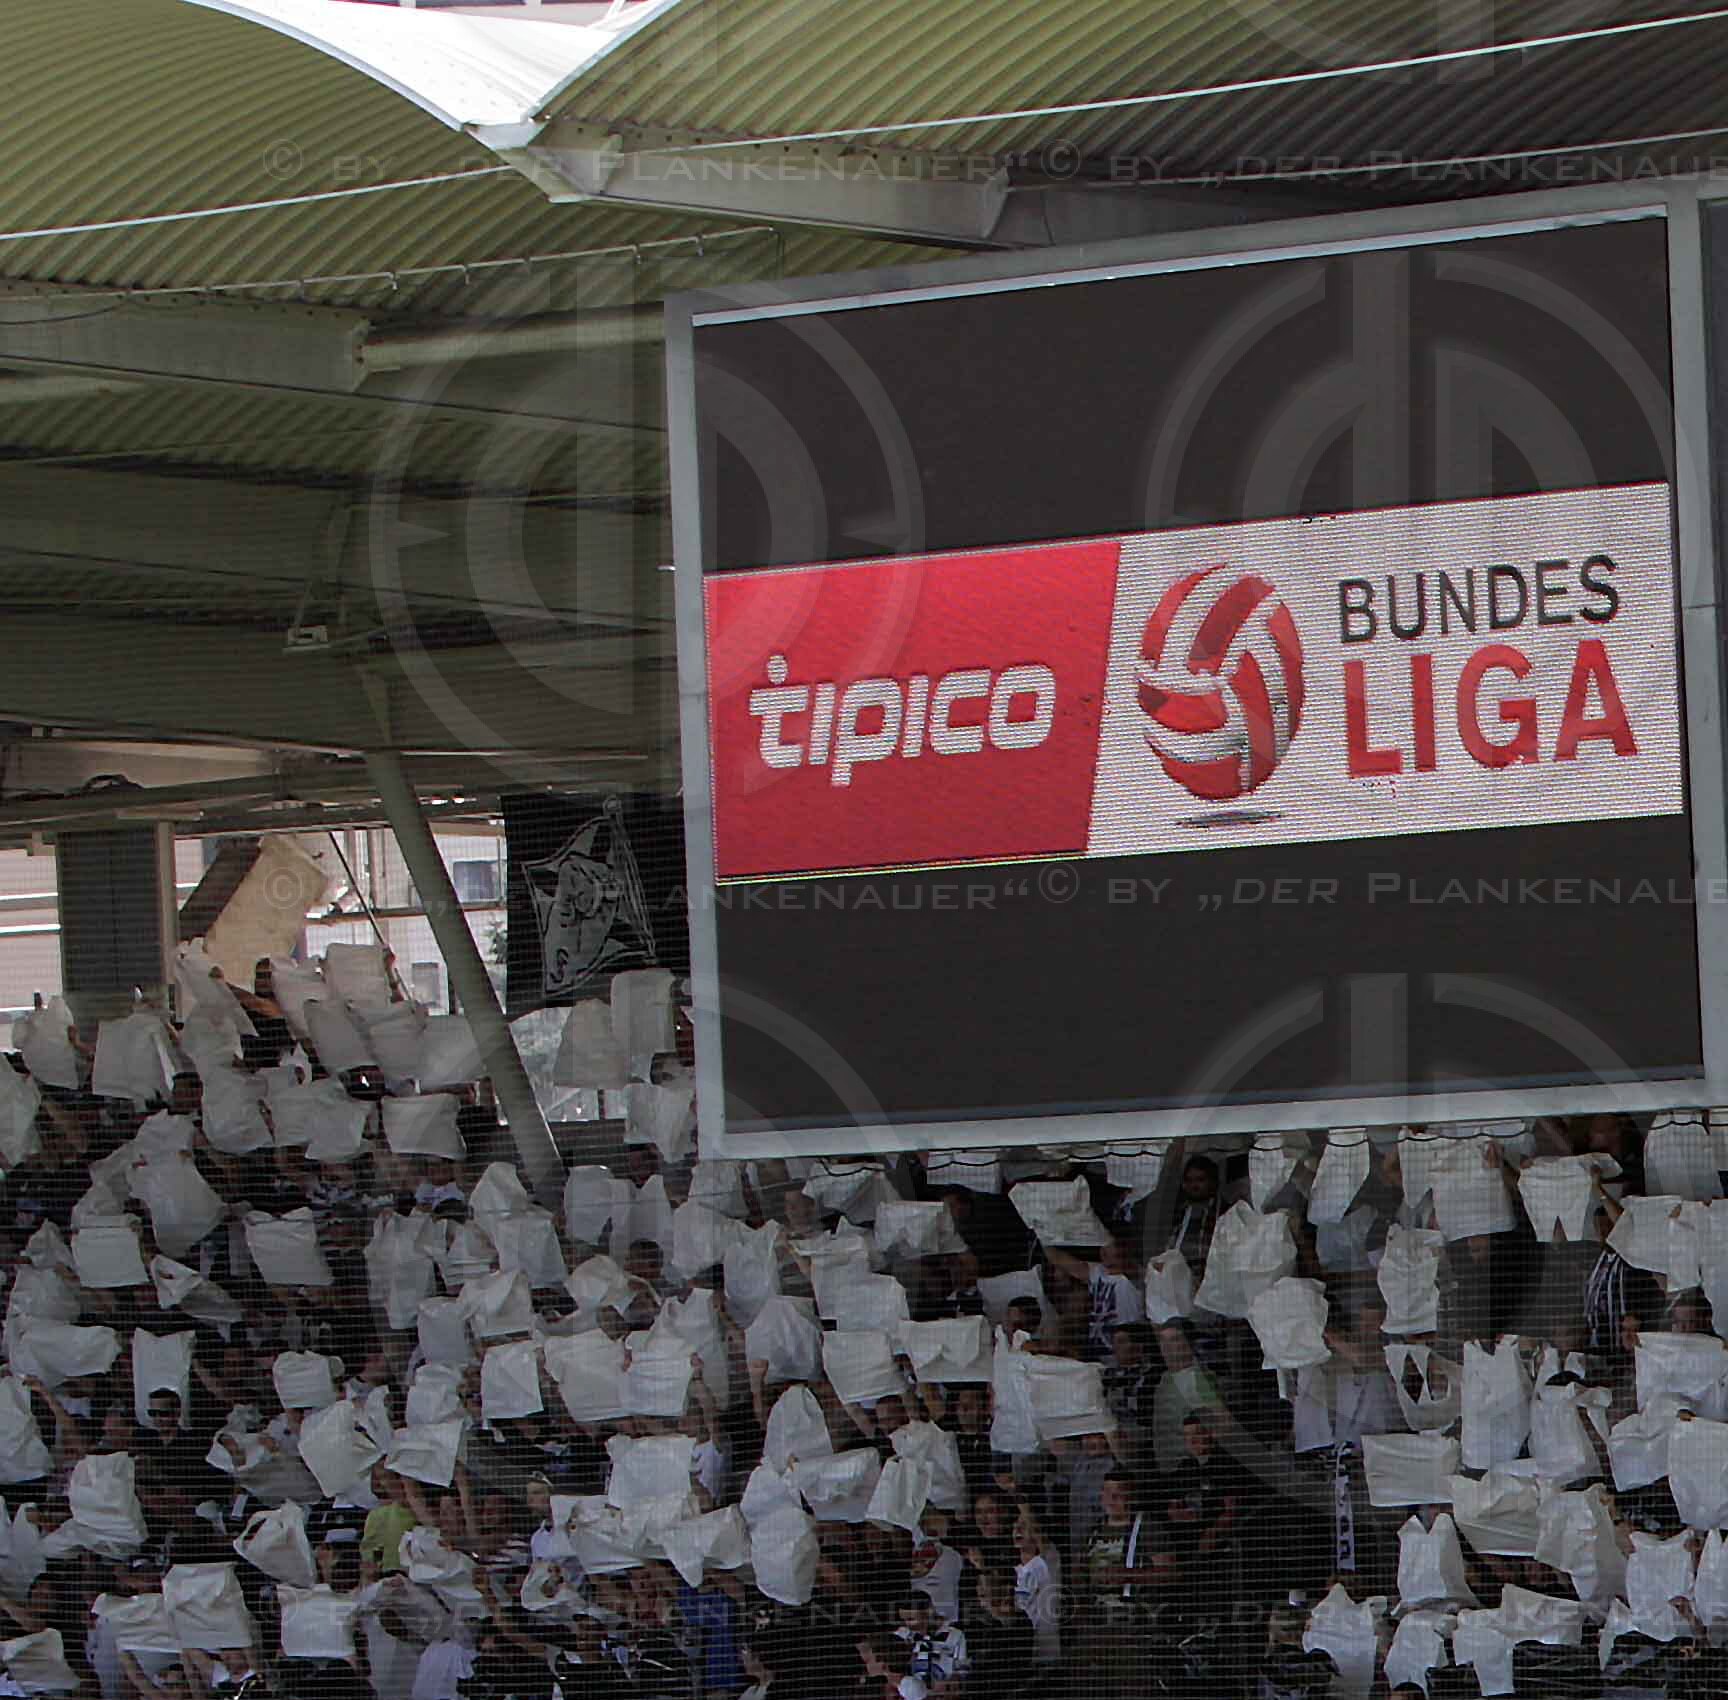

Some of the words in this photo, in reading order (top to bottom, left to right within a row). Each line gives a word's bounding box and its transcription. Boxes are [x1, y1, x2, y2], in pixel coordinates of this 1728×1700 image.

[1338, 554, 1622, 643] BUNDES
[749, 655, 1057, 786] tipico
[1342, 638, 1638, 780] LIGA
